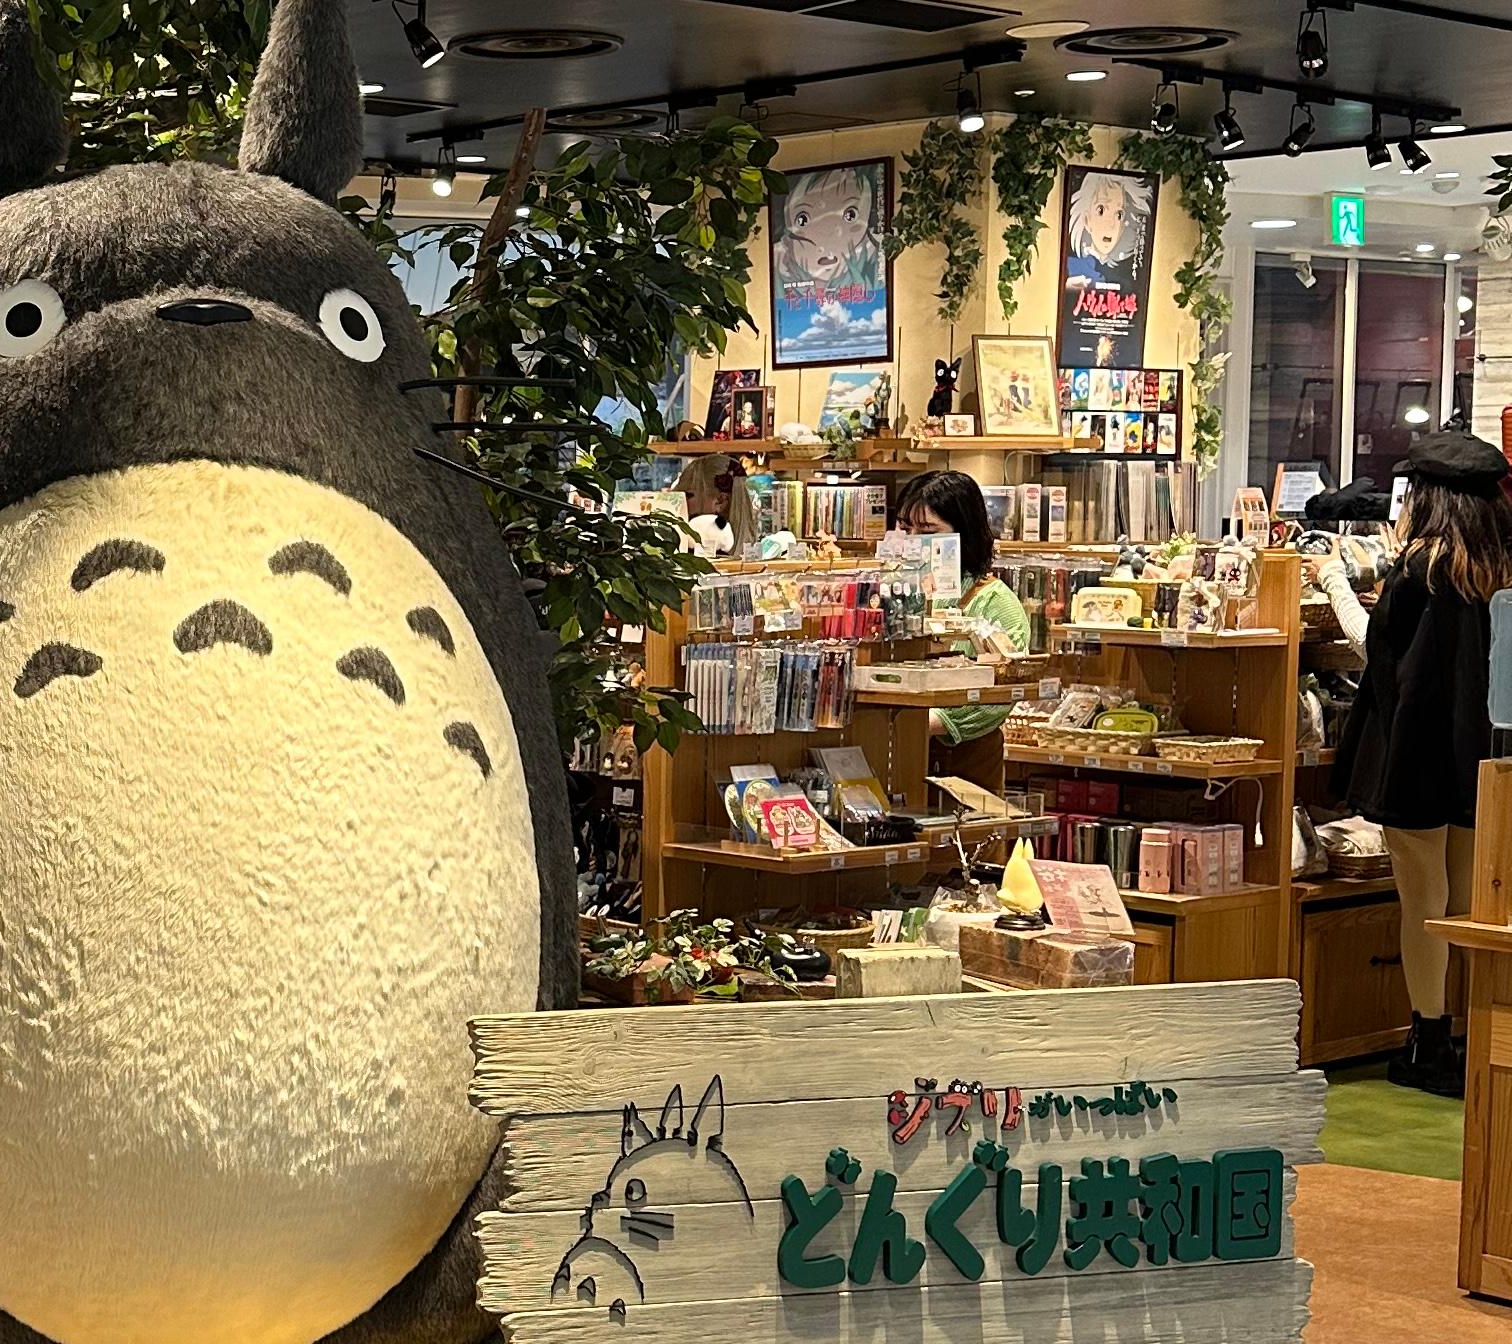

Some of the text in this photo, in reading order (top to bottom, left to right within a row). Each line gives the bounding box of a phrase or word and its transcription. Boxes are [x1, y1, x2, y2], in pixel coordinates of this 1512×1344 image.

[777, 1139, 1284, 1289] どんぐり共和国
